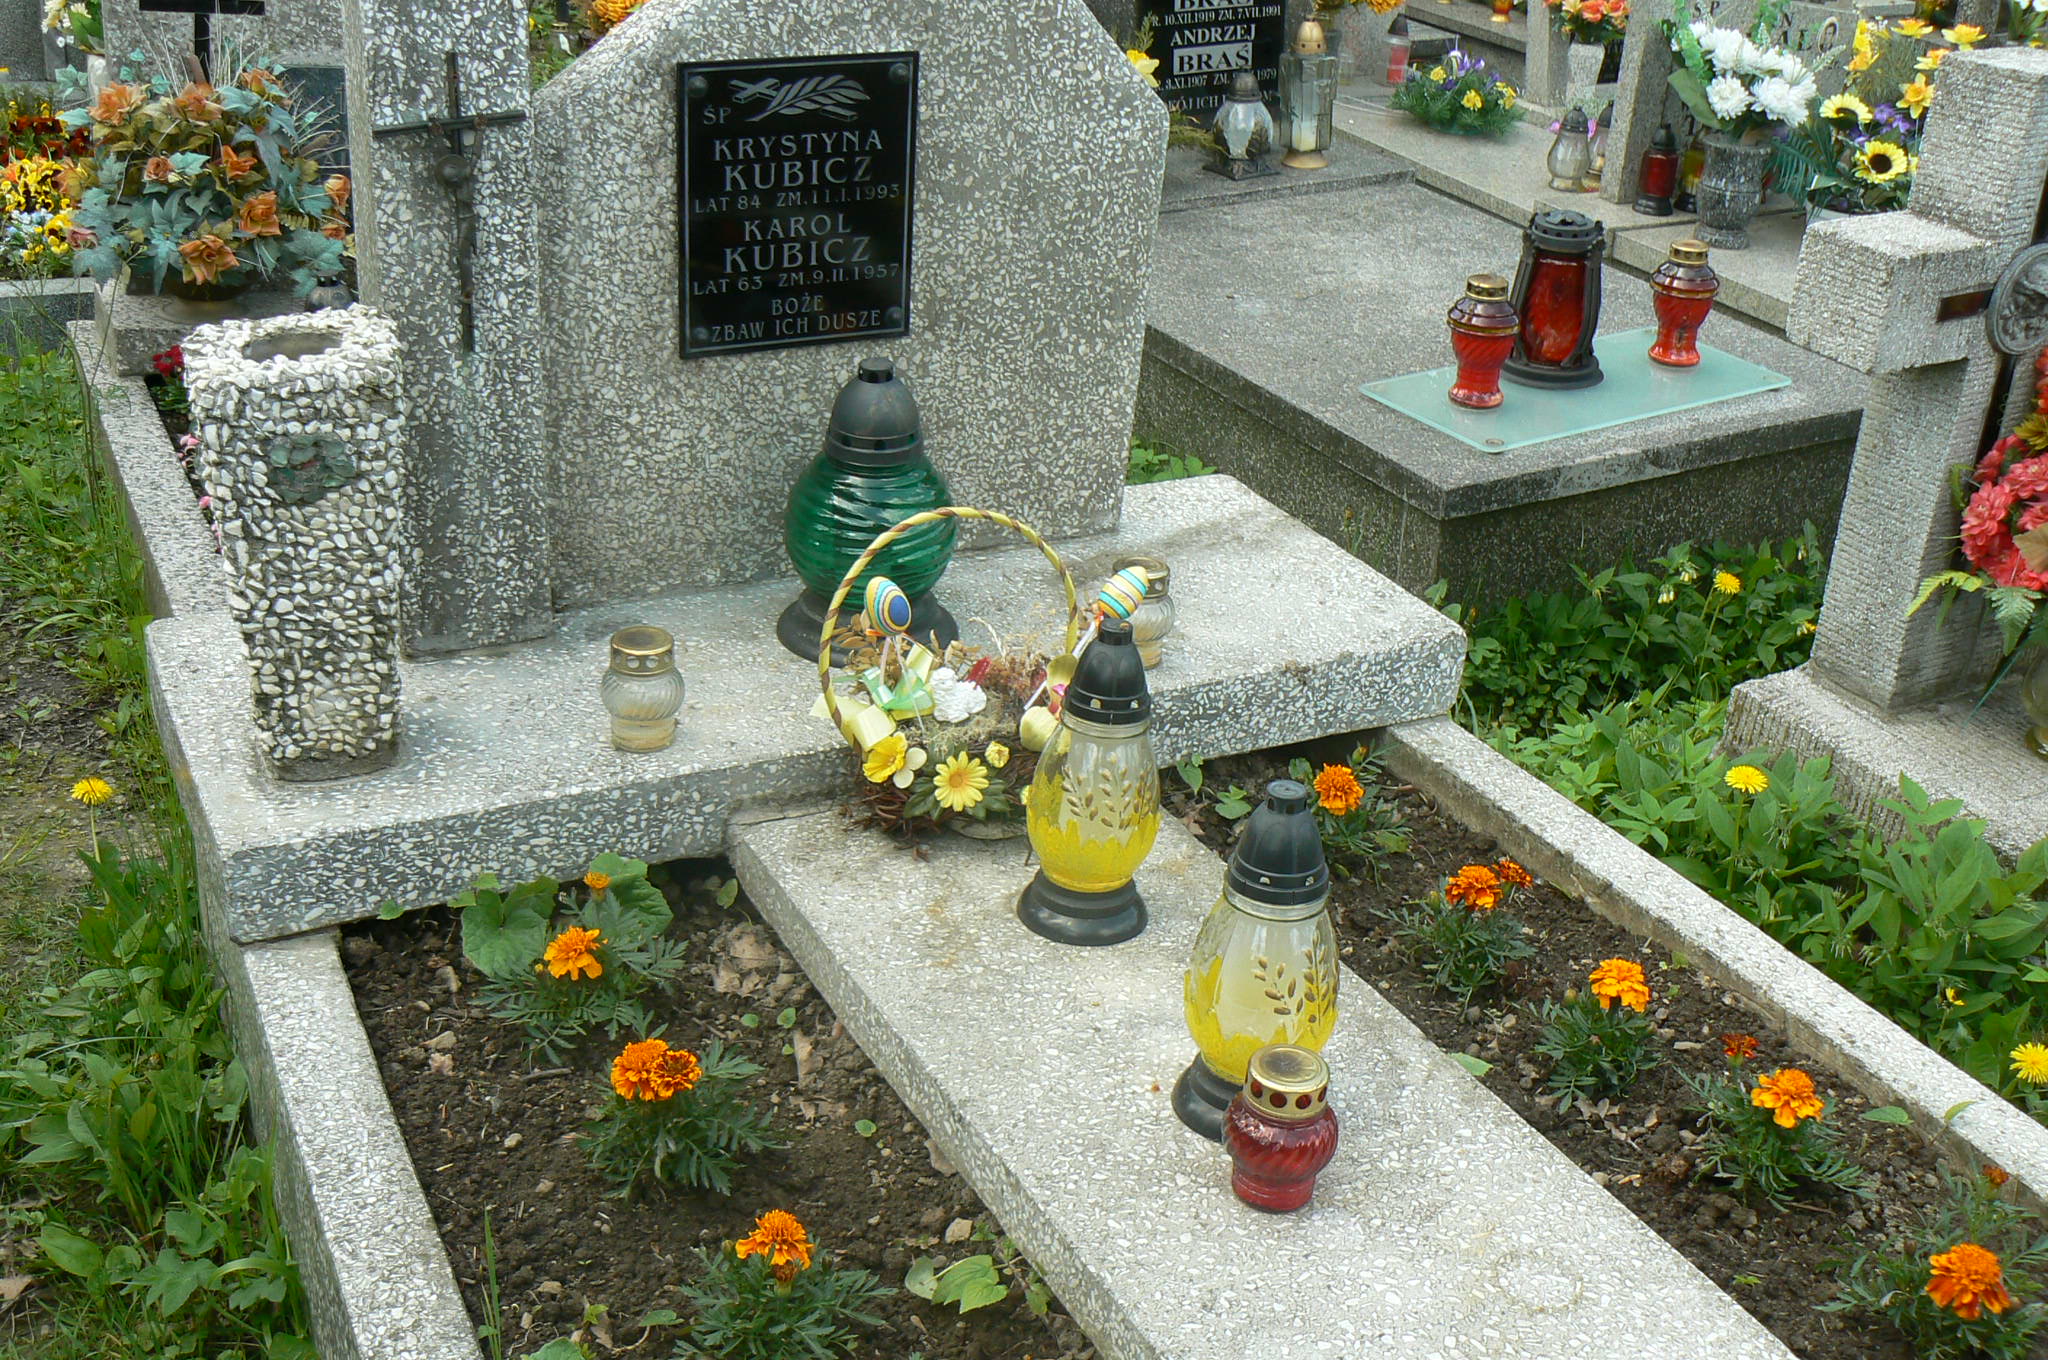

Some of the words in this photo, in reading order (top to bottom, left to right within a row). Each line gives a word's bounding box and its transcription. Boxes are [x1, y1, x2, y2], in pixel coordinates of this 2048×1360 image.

[1170, 23, 1256, 47] ANDRZEJ
[1179, 43, 1249, 72] BRAŚ
[713, 129, 883, 161] KRYSTYNA
[724, 156, 873, 193] KUBICZ
[695, 197, 731, 214] LAT
[738, 194, 761, 211] 84
[743, 213, 852, 242] KAROL
[723, 236, 871, 274] KUBICZ
[693, 279, 731, 296] LAT
[771, 292, 824, 316] BOŻE
[711, 320, 766, 343] ZBAW
[775, 317, 808, 336] ICH
[818, 309, 881, 332] DUSZE
